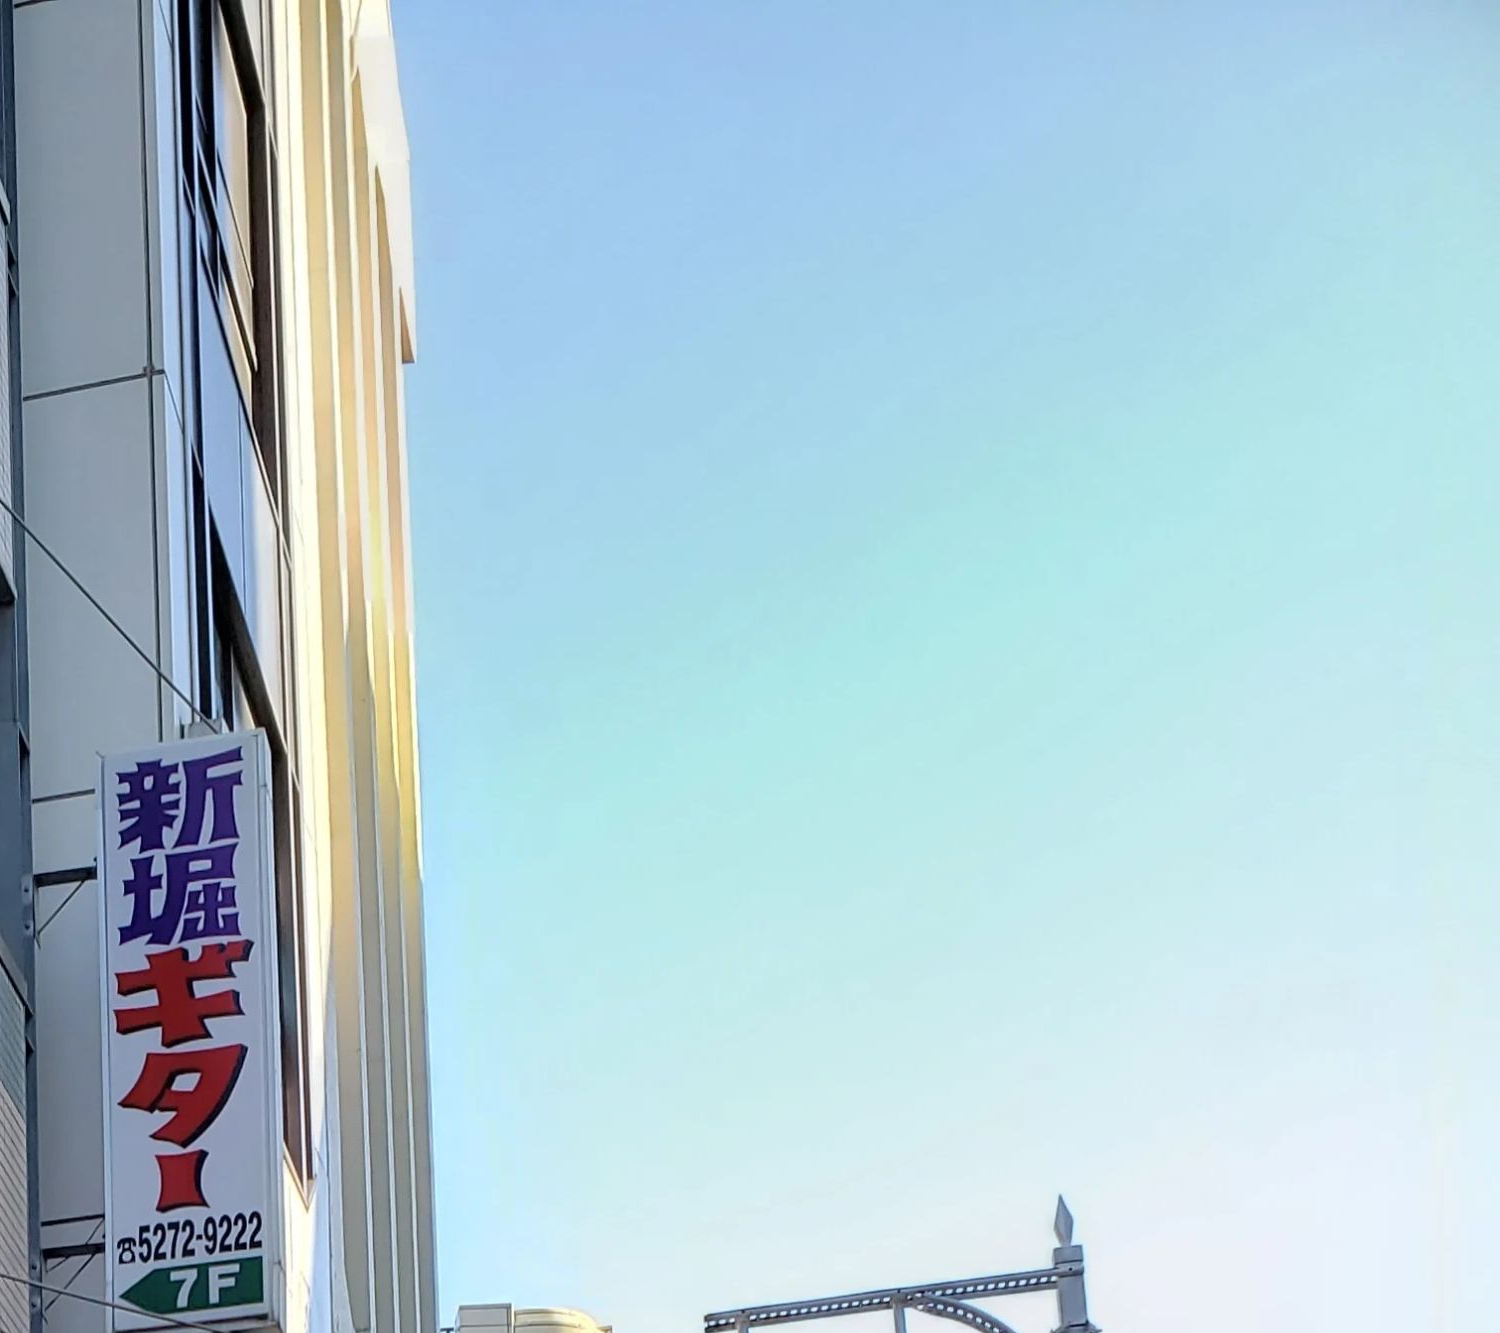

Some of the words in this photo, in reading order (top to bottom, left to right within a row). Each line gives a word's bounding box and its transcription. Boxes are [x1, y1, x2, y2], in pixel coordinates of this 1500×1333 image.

[115, 746, 254, 1213] 新堀ギター
[138, 1211, 263, 1263] 5272-9222
[169, 1262, 241, 1309] 7F
